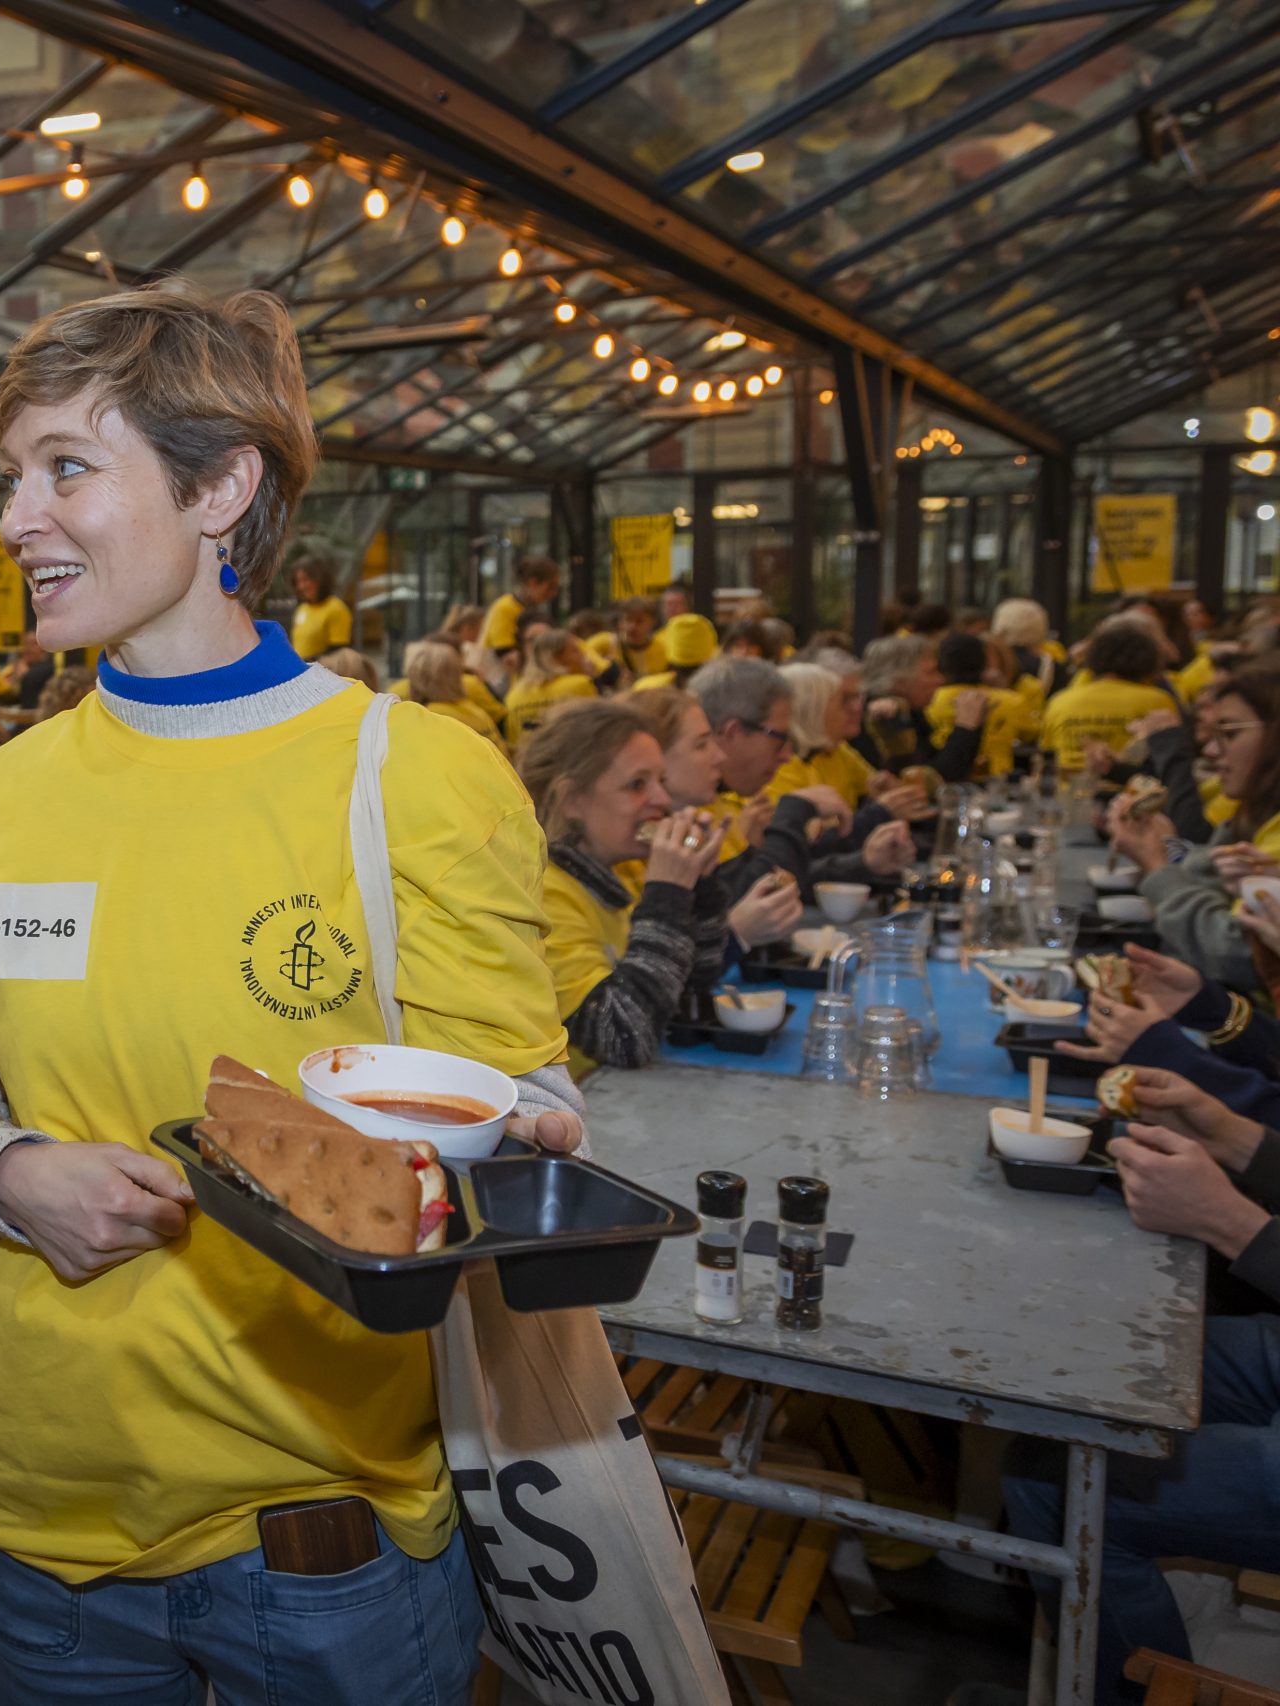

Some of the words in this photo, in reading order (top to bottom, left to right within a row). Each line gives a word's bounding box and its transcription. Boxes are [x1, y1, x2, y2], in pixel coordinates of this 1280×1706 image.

[241, 899, 287, 946] AMNESTY
[239, 957, 317, 1021] INTERNATIONAL
[320, 967, 363, 1014] AMNESTY
